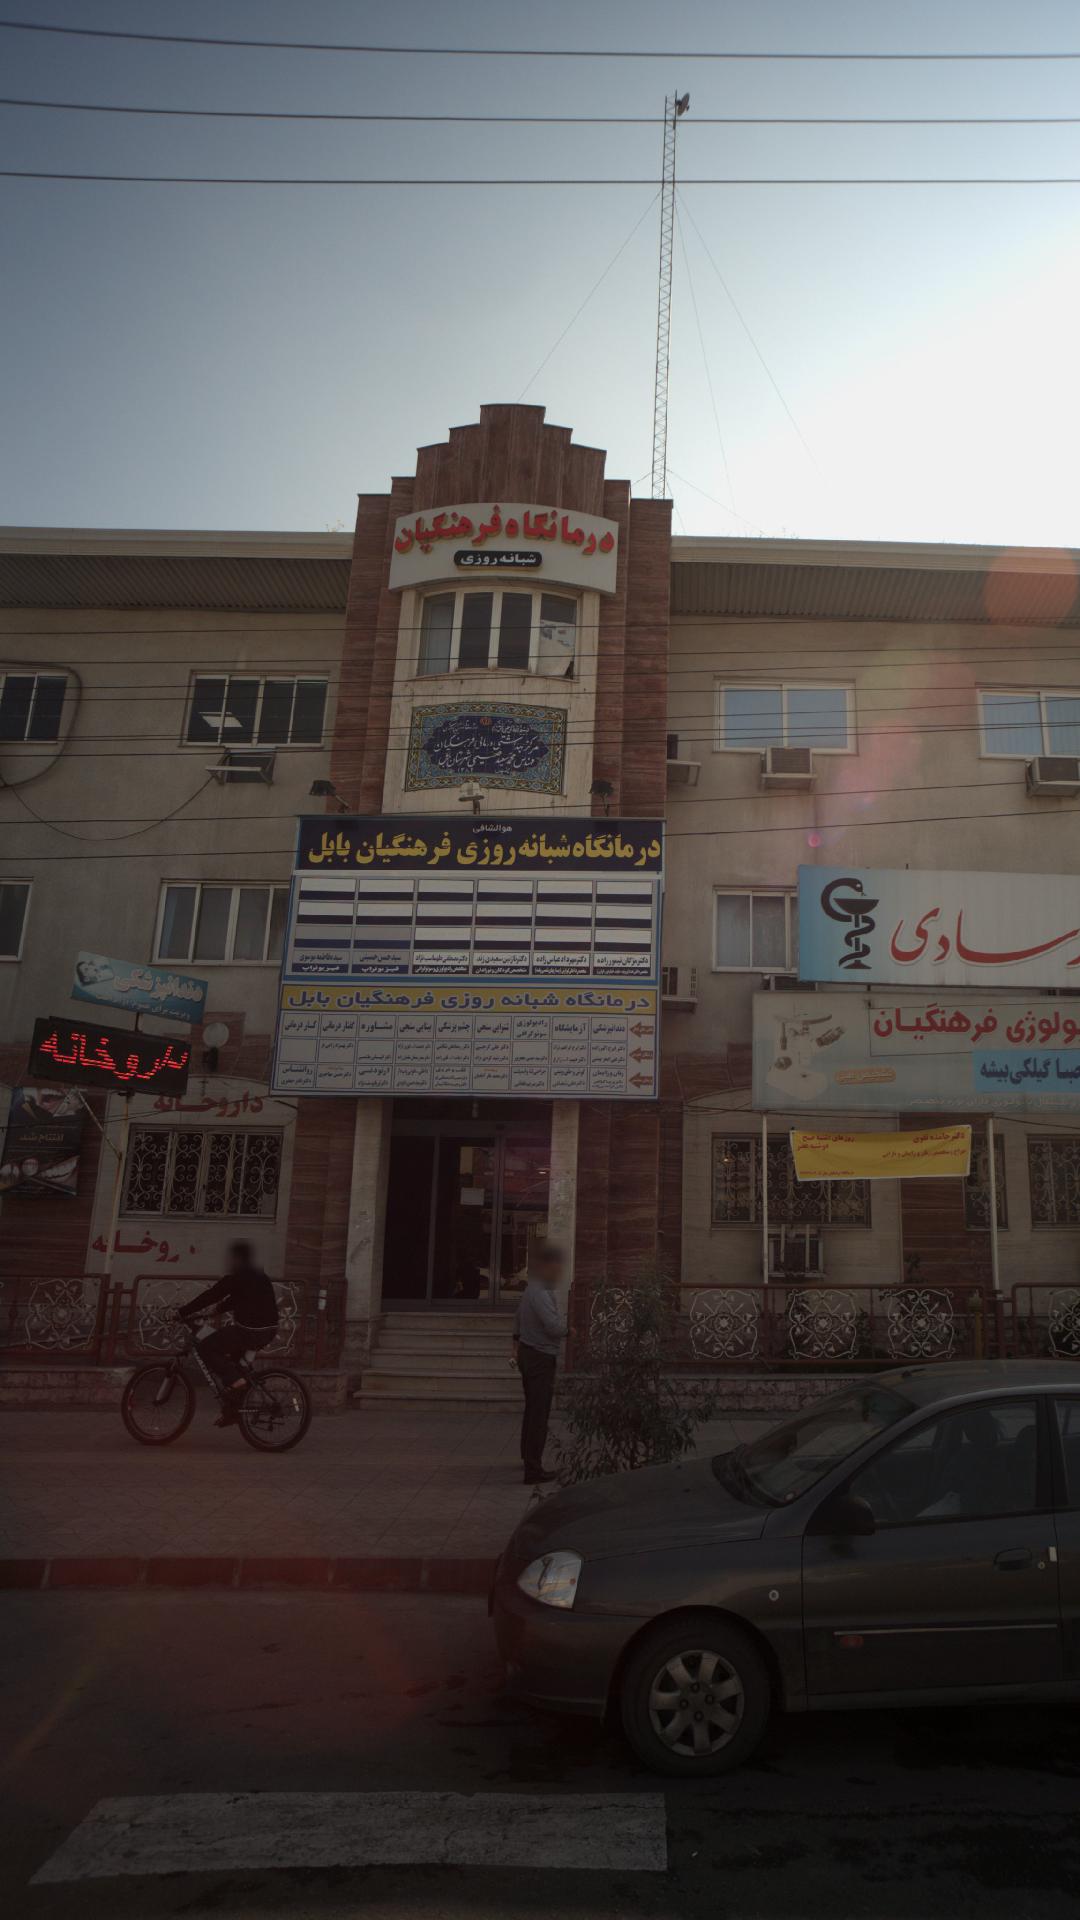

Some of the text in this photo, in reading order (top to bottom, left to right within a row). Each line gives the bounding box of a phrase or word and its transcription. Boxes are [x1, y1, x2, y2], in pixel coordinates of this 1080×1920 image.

[394, 505, 615, 555] درمانگاه فرهنگیان
[460, 553, 537, 565] شبانه روزی
[308, 831, 661, 866] درمانگاه شبانه روزی فرهنگیان بابل
[288, 989, 651, 1011] درمانگاه شبانه روزی فرهنگیان بابل
[873, 1002, 998, 1043] فرهنگیان
